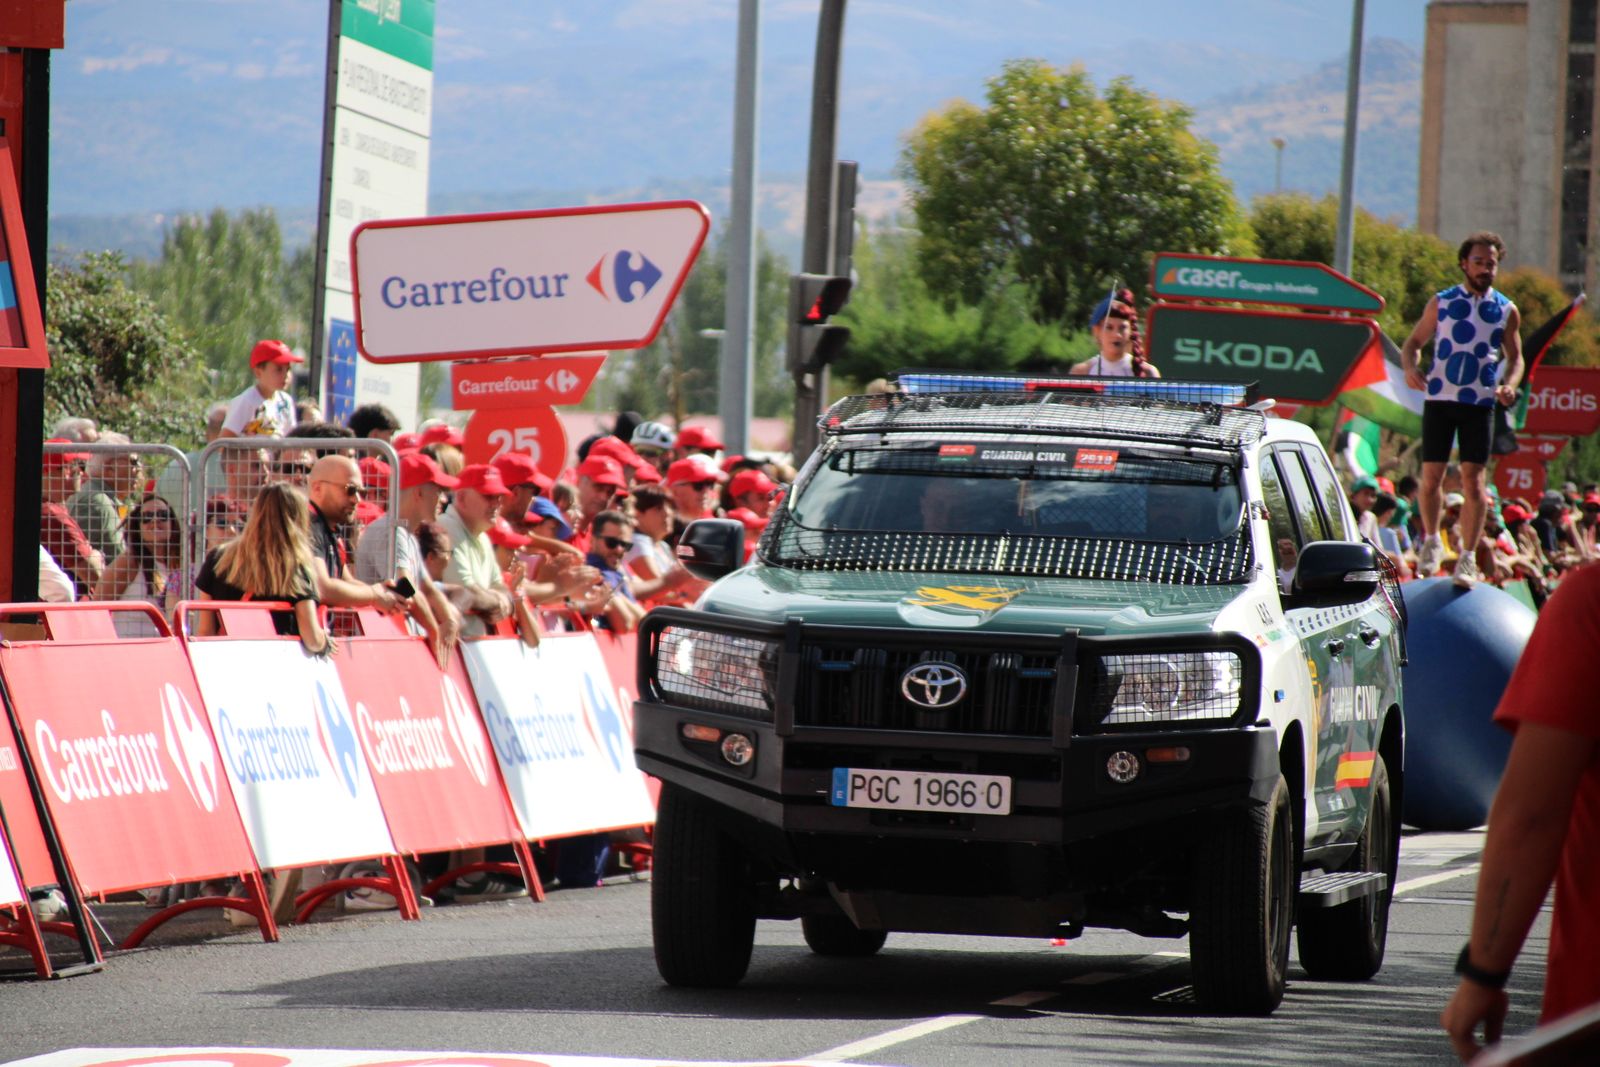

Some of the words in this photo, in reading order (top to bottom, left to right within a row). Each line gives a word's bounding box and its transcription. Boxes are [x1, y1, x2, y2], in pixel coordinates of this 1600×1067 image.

[381, 268, 569, 309] Carrefour
[1177, 267, 1241, 288] caser
[459, 376, 539, 395] Carrefour
[1527, 387, 1597, 411] ofidis
[488, 427, 541, 463] 25
[981, 450, 1033, 461] GUARDIA
[1036, 452, 1067, 463] CIVIL
[1506, 468, 1533, 489] 75
[218, 702, 320, 785] Carrefour
[355, 696, 454, 775] Carrefour
[485, 693, 585, 767] Carrefour
[35, 709, 169, 804] Carrefour
[851, 774, 900, 804] PGC
[913, 777, 977, 808] 1966
